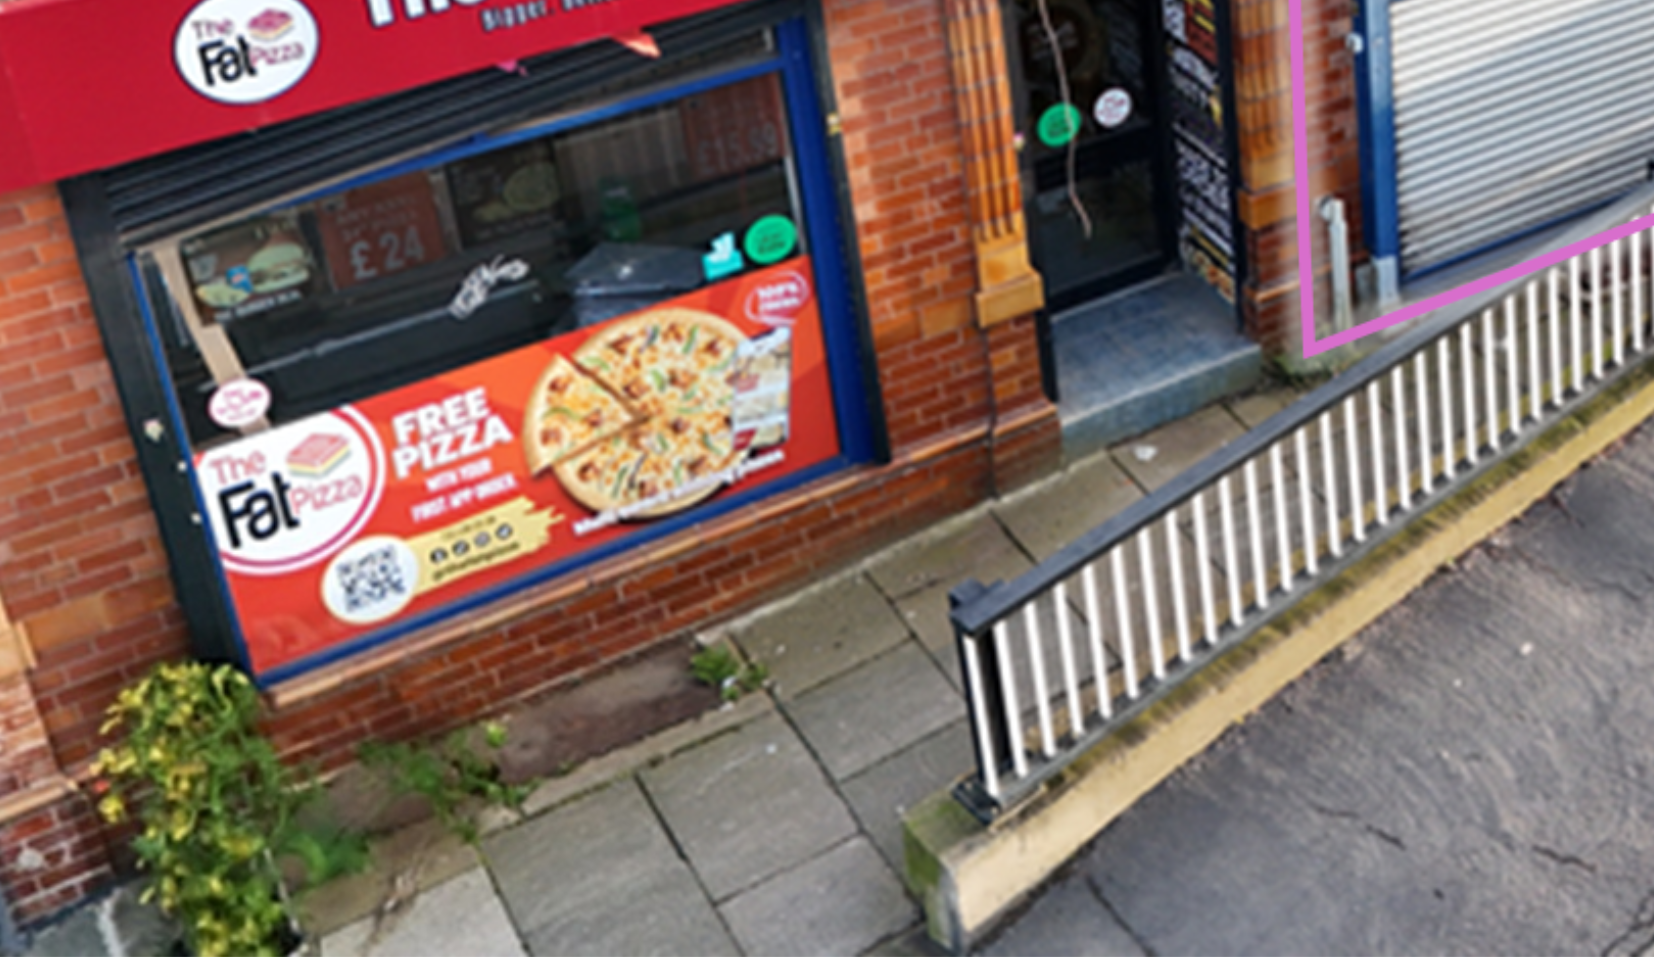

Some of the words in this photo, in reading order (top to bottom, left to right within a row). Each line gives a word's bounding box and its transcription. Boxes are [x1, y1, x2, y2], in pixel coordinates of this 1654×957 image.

[191, 18, 234, 40] The
[198, 34, 258, 87] Fat
[249, 42, 305, 67] Pizza
[393, 386, 490, 445] FREE
[208, 450, 266, 485] The
[393, 415, 513, 480] PIZZA
[218, 471, 300, 549] Fat
[290, 474, 363, 516] Pizza
